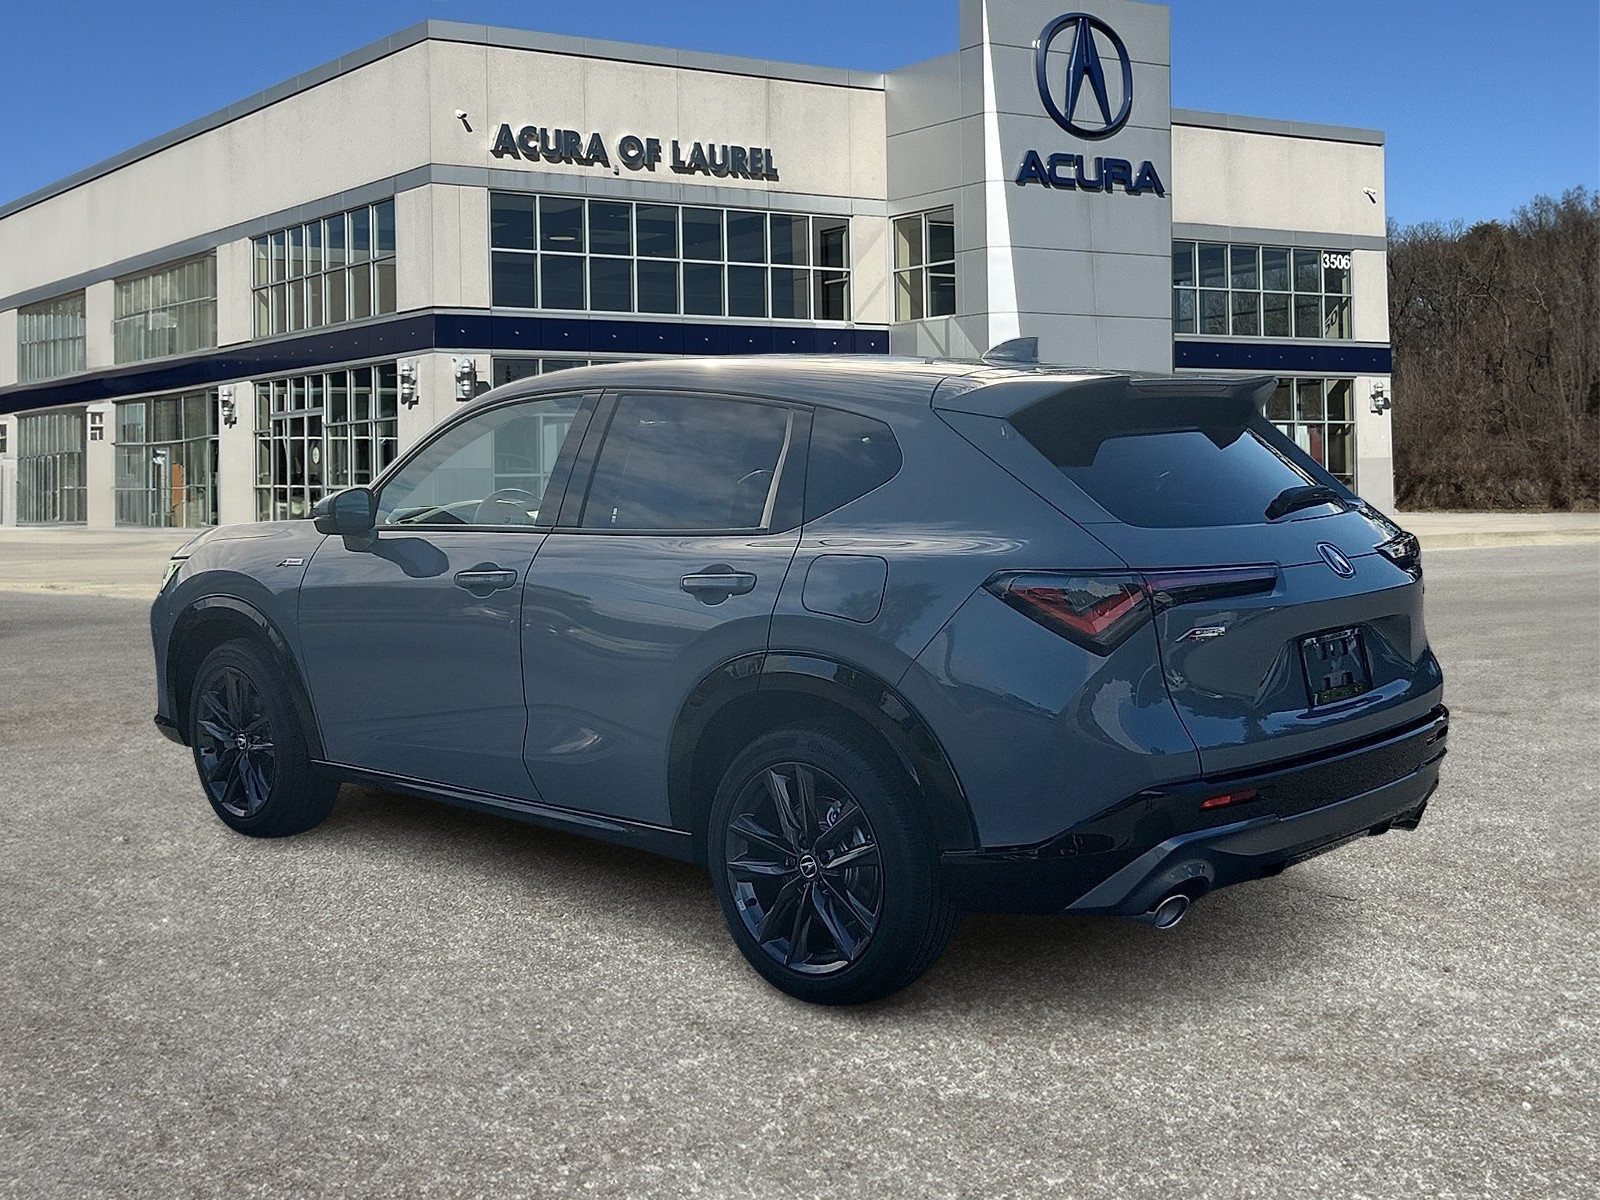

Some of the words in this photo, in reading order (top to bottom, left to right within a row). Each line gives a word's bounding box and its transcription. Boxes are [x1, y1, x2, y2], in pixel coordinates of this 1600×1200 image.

[490, 123, 611, 167] ACURA
[618, 135, 662, 172] OF
[670, 140, 780, 182] LAUREL
[1015, 150, 1165, 198] ACURA
[1322, 253, 1350, 269] 3506
